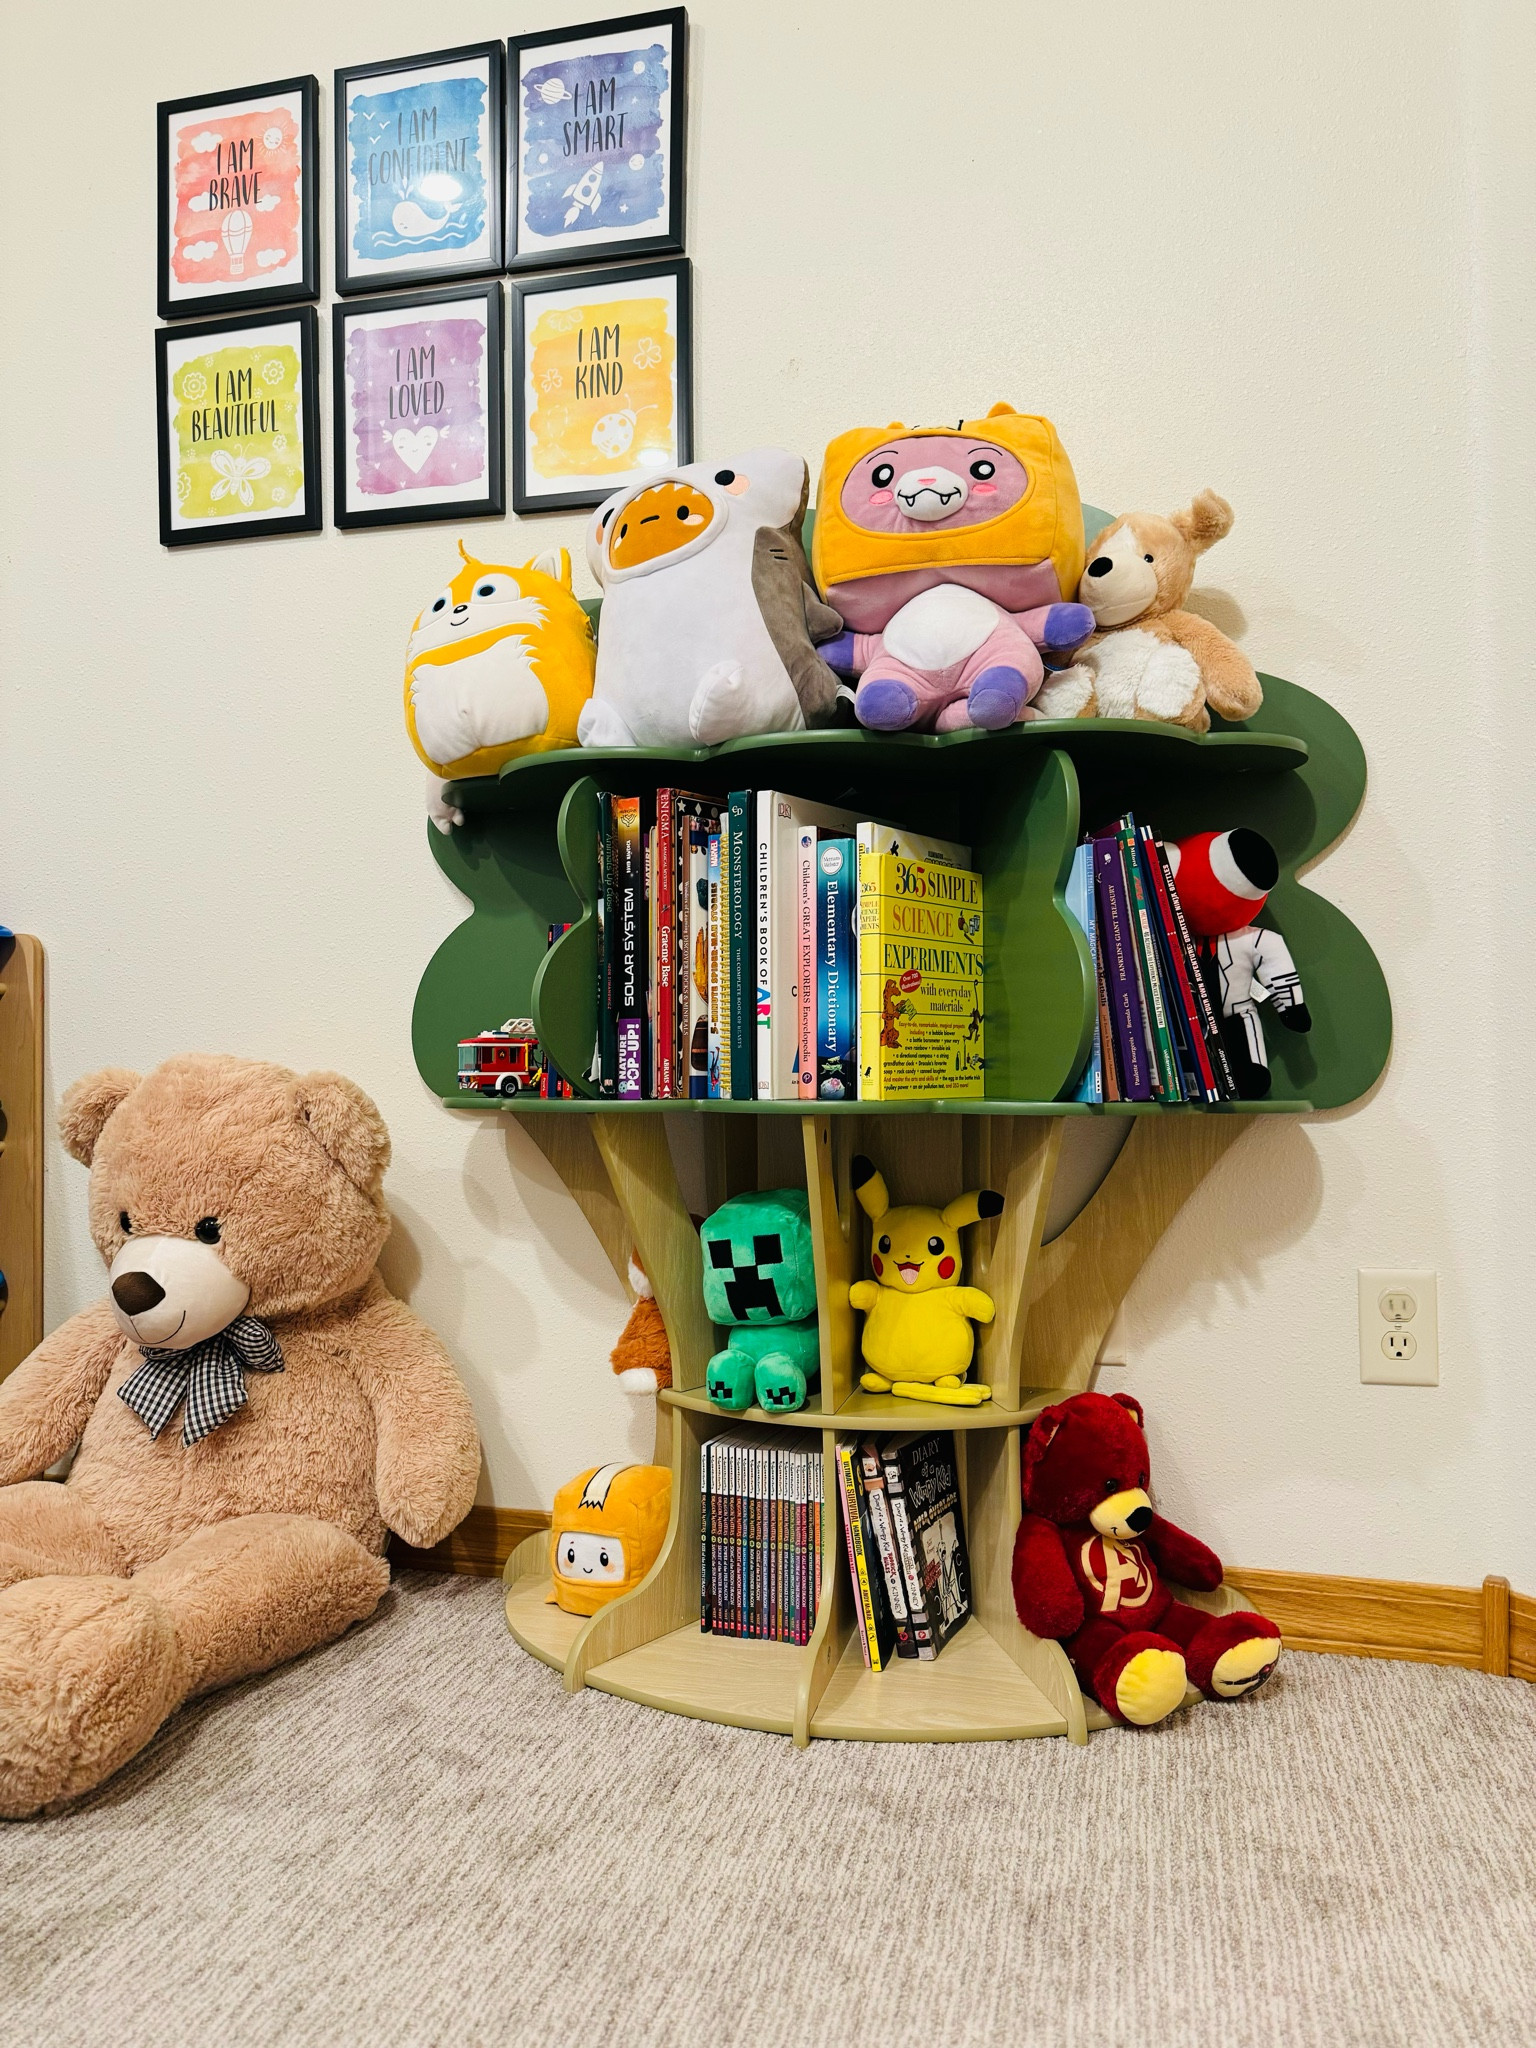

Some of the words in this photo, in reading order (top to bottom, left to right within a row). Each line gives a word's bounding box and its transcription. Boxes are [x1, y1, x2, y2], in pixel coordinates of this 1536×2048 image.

[573, 86, 581, 118] I
[585, 76, 618, 113] AM
[398, 116, 404, 146] I
[408, 106, 438, 142] AM
[562, 111, 630, 158] SMART
[216, 148, 222, 177] I
[225, 138, 255, 174] AM
[367, 136, 472, 187] CONFIDENT
[208, 171, 263, 212] BRAVE
[577, 329, 585, 364] I
[589, 323, 622, 362] AM
[395, 348, 401, 383] I
[406, 344, 436, 382] AM
[574, 361, 624, 401] KIND
[214, 372, 221, 402] I
[225, 366, 253, 401] AM
[389, 383, 445, 421] LOVED
[191, 400, 280, 443] BEAUTIFUL
[661, 794, 669, 840] ENIGMA
[710, 840, 718, 867] MARVEL
[1130, 846, 1138, 867] Milord
[759, 842, 768, 923] CHILDREN'S
[802, 859, 811, 905] Children's
[896, 863, 926, 898] 365
[928, 871, 978, 905] SIMPLE
[1162, 864, 1176, 892] BATTLES
[624, 887, 634, 952] SYSTEM
[710, 882, 718, 922] STORIES
[1108, 884, 1119, 919] TREASURY
[1171, 892, 1182, 911] NINJA
[802, 907, 811, 945] GREAT
[825, 881, 839, 967] Elementary
[892, 904, 954, 938] SCIENCE
[1088, 919, 1095, 928] MY
[1112, 920, 1121, 941] GIANT
[1176, 911, 1191, 943] GREATEST
[661, 926, 671, 963] Graeme
[759, 927, 768, 965] BOOK
[884, 943, 984, 977] EXPERIMENTS
[1116, 941, 1127, 981] FRANKLIN'S
[1186, 943, 1203, 982] ADVENTURE:
[624, 954, 634, 1007] SOLAR
[661, 965, 671, 988] Base
[759, 968, 768, 986] OF
[802, 946, 811, 1004] EXPLORERS
[920, 983, 937, 997] with
[938, 985, 972, 1002] everyday
[1098, 972, 1106, 1007] Meatballs
[1198, 983, 1207, 998] OWN
[711, 986, 719, 1035] 5-MINUTE
[757, 987, 771, 1030] ART
[825, 970, 839, 1053] Dictionary
[930, 999, 963, 1013] materials
[1203, 999, 1213, 1016] YOUR
[802, 1006, 811, 1063] Encyclopedia
[1208, 1016, 1219, 1035] BUILD
[619, 1034, 627, 1080] NATURE
[626, 1023, 640, 1091] POP-UP!
[911, 1438, 940, 1466] DIARY
[843, 1461, 853, 1487] ULTIMATE
[909, 1480, 937, 1508] Wimpy
[936, 1465, 952, 1493] Kid
[847, 1488, 859, 1524] SURVIVAL
[873, 1493, 882, 1511] Diary
[852, 1524, 862, 1556] HANDBOOK
[891, 1586, 902, 1615] KINNEY
[910, 1582, 919, 1608] KINNEY
